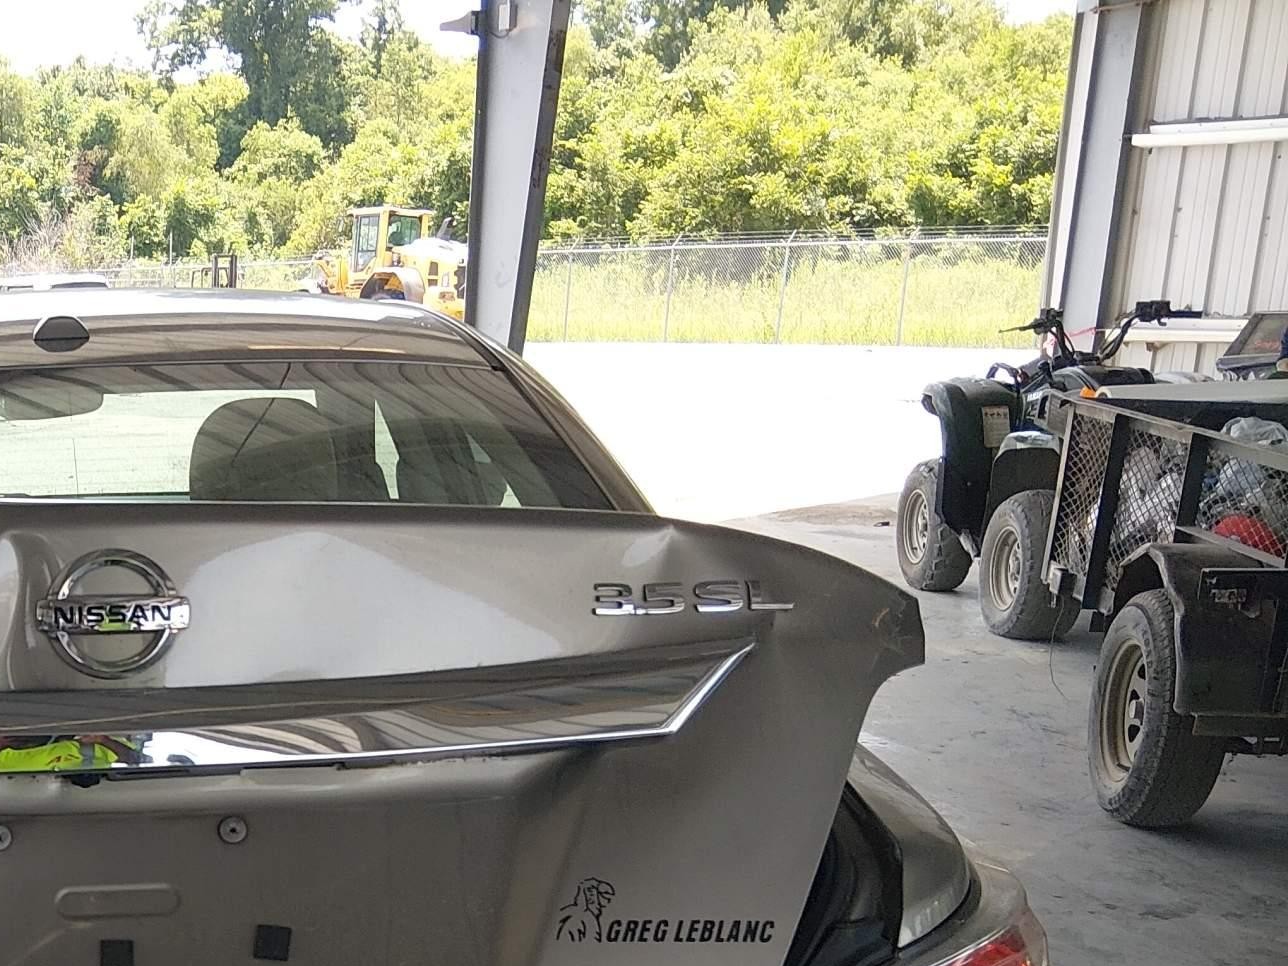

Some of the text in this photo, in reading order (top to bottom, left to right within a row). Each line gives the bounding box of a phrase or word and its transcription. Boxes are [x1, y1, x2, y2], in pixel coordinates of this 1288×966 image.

[54, 604, 172, 625] NISSAN
[606, 919, 776, 943] GREG LEBLANC
